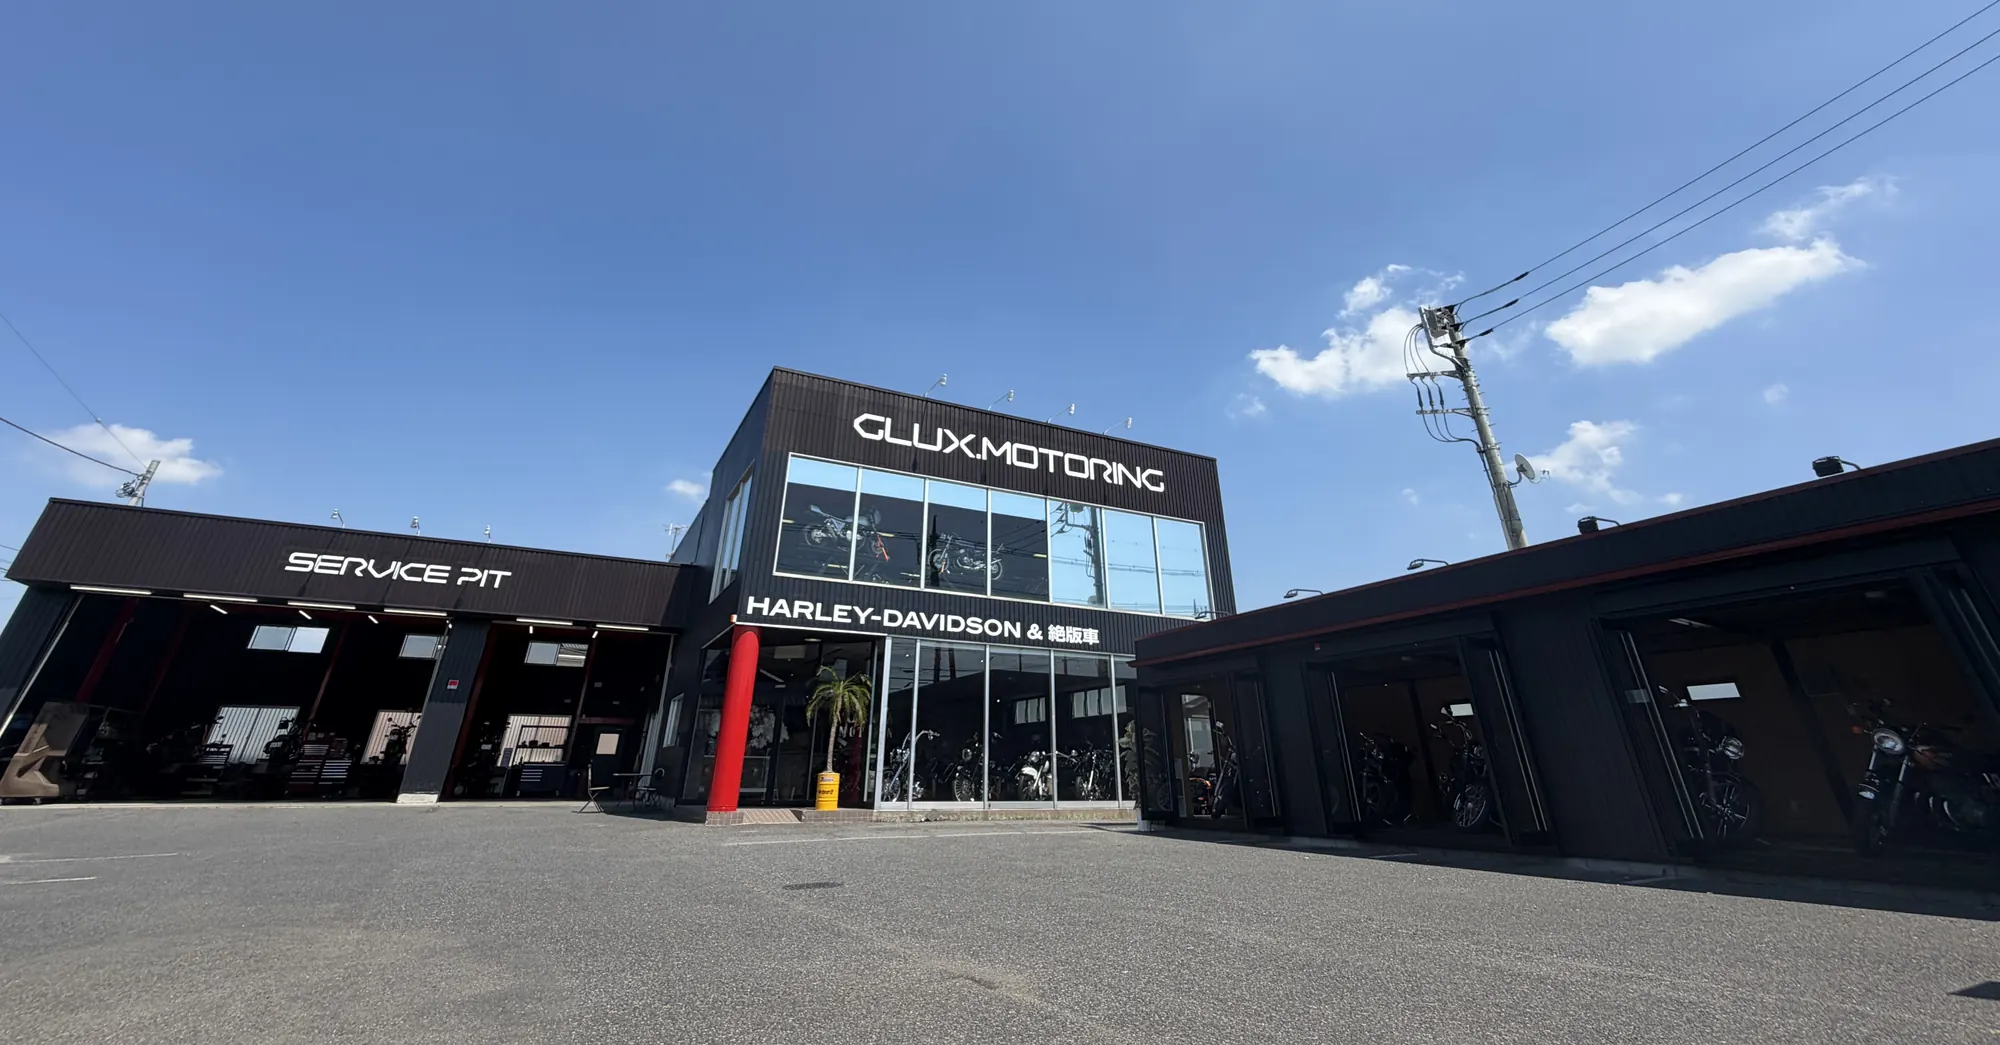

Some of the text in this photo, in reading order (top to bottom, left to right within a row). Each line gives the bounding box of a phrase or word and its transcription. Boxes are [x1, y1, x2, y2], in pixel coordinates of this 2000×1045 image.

[853, 413, 1164, 493] GLUX.MOTORING
[285, 552, 512, 589] SERVICE PIT
[746, 596, 1100, 646] HARLEY-DAVIDSON & 絶版車
